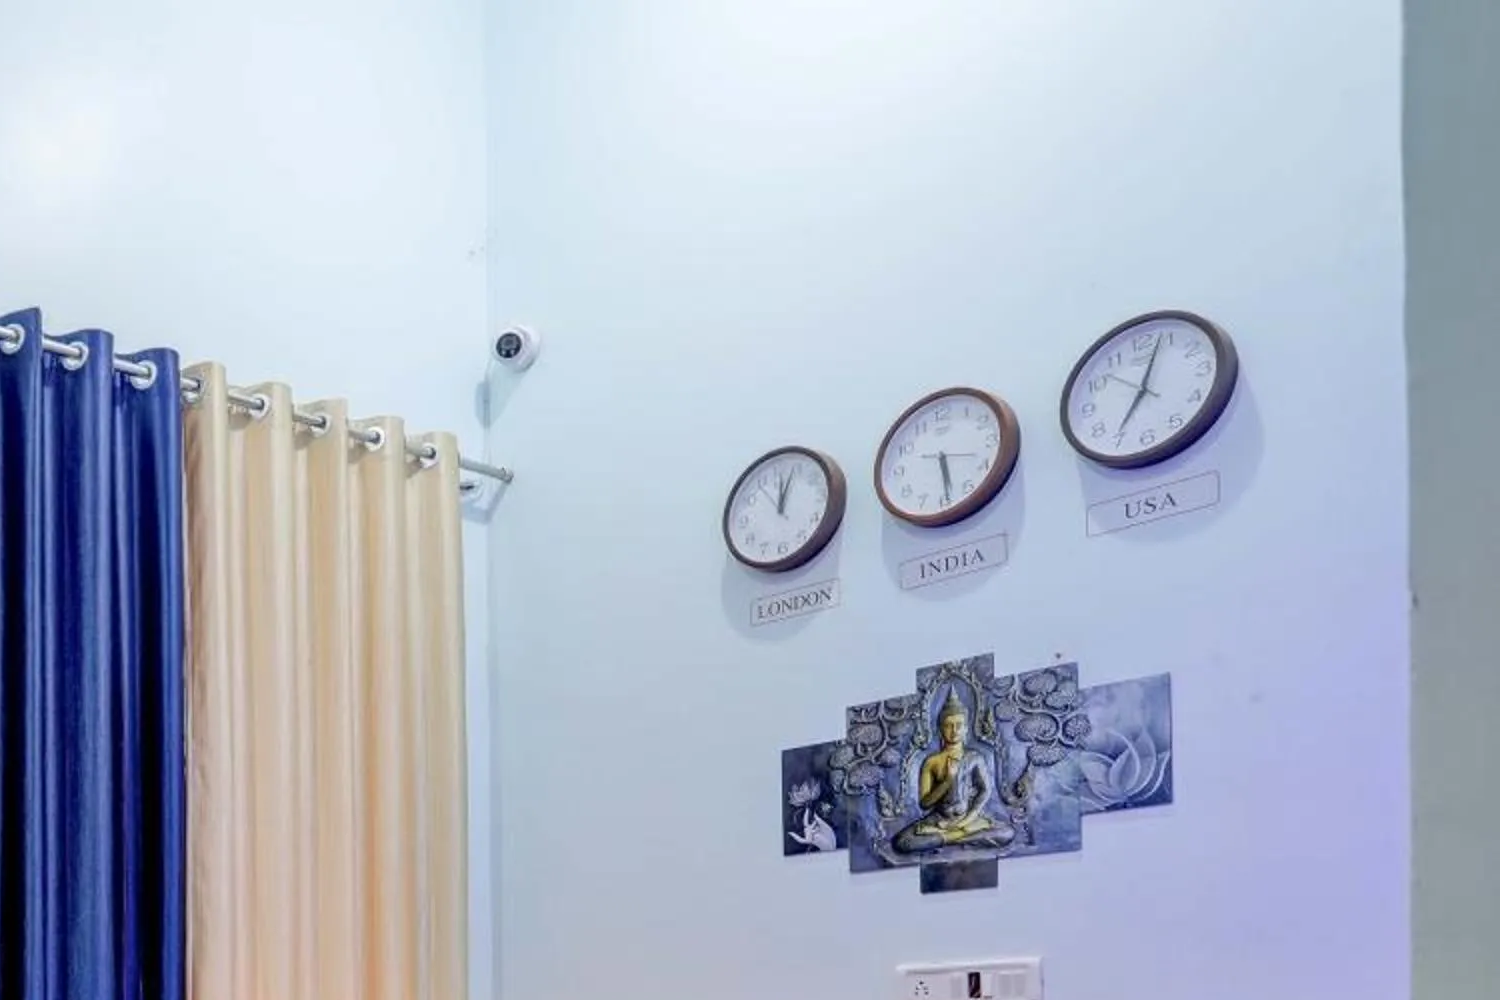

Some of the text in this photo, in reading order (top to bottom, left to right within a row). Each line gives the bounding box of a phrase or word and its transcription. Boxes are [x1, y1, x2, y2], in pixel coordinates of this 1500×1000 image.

[1132, 333, 1153, 352] 12
[1166, 332, 1174, 345] 1
[1108, 353, 1122, 368] 11
[1088, 375, 1107, 393] 10
[1187, 389, 1201, 404] 4
[934, 407, 950, 422] 12
[1082, 403, 1096, 418] 9
[915, 423, 927, 435] 11
[1168, 413, 1183, 429] 5
[1091, 422, 1107, 438] 8
[1140, 429, 1155, 446] 6
[899, 443, 914, 456] 10
[1124, 492, 1176, 519] USA
[920, 549, 985, 579] INDIA
[758, 588, 833, 619] LONDON
